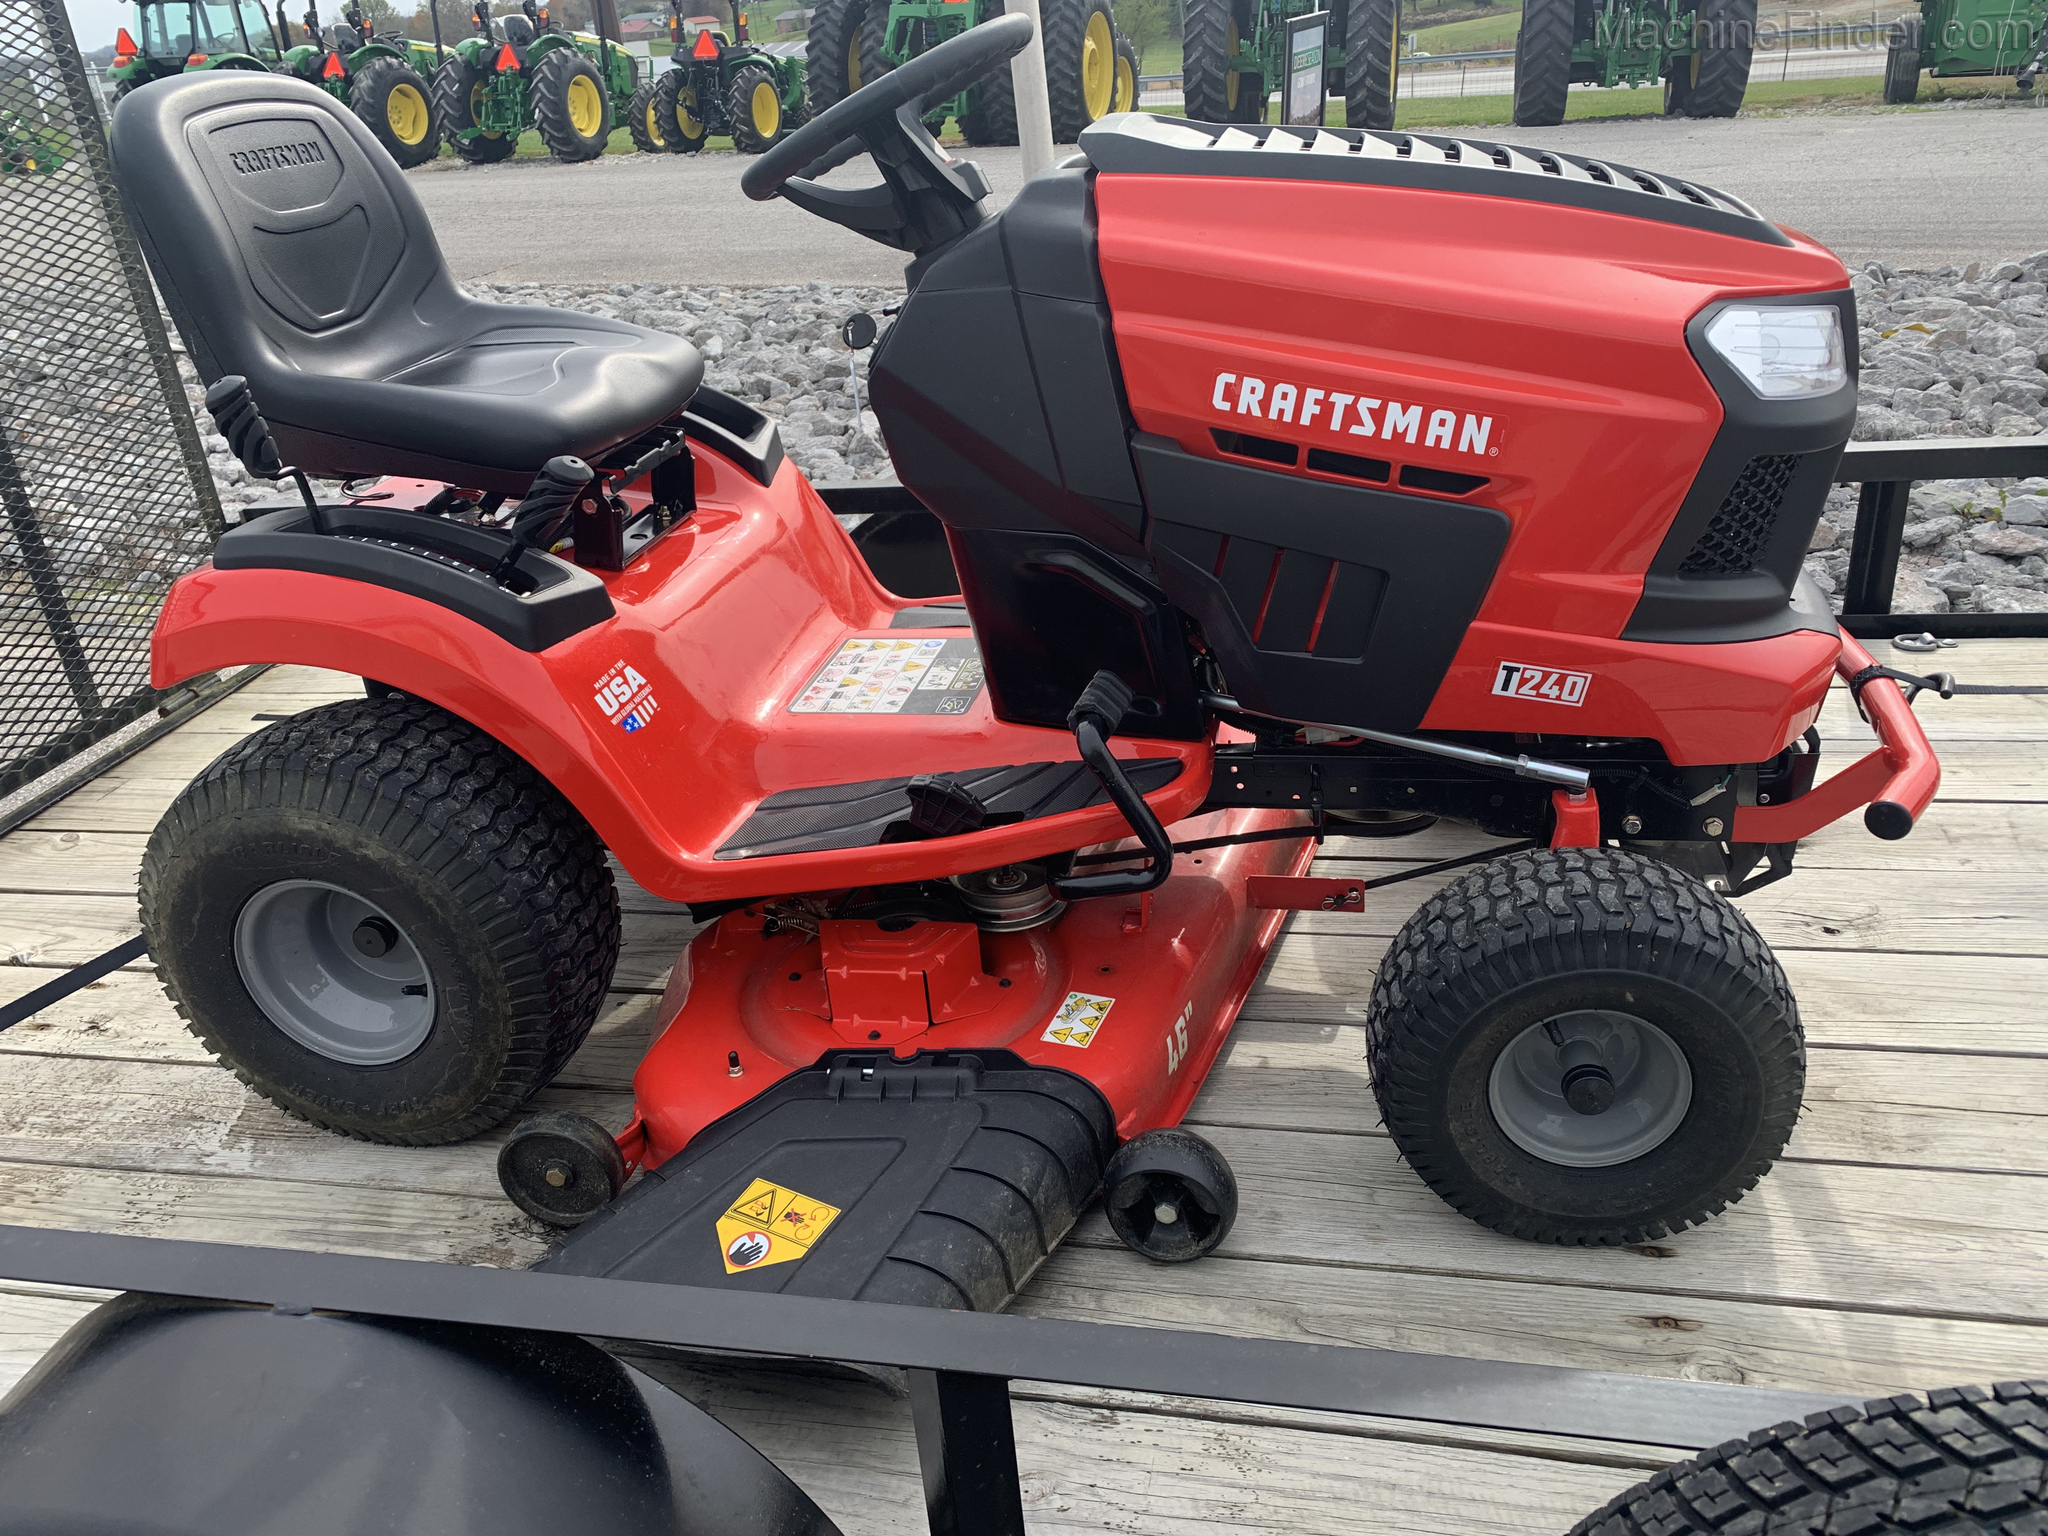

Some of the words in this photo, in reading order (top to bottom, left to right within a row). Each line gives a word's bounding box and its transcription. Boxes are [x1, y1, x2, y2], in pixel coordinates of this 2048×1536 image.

[229, 141, 325, 175] CRAFTSMAN
[1212, 371, 1493, 455] CRAFTSMAN
[593, 673, 611, 690] MADE
[608, 667, 617, 677] IN
[614, 659, 626, 670] THE
[594, 665, 647, 716] USA
[1500, 664, 1586, 702] T240
[610, 712, 623, 726] WITH
[620, 701, 636, 717] GLOBAL
